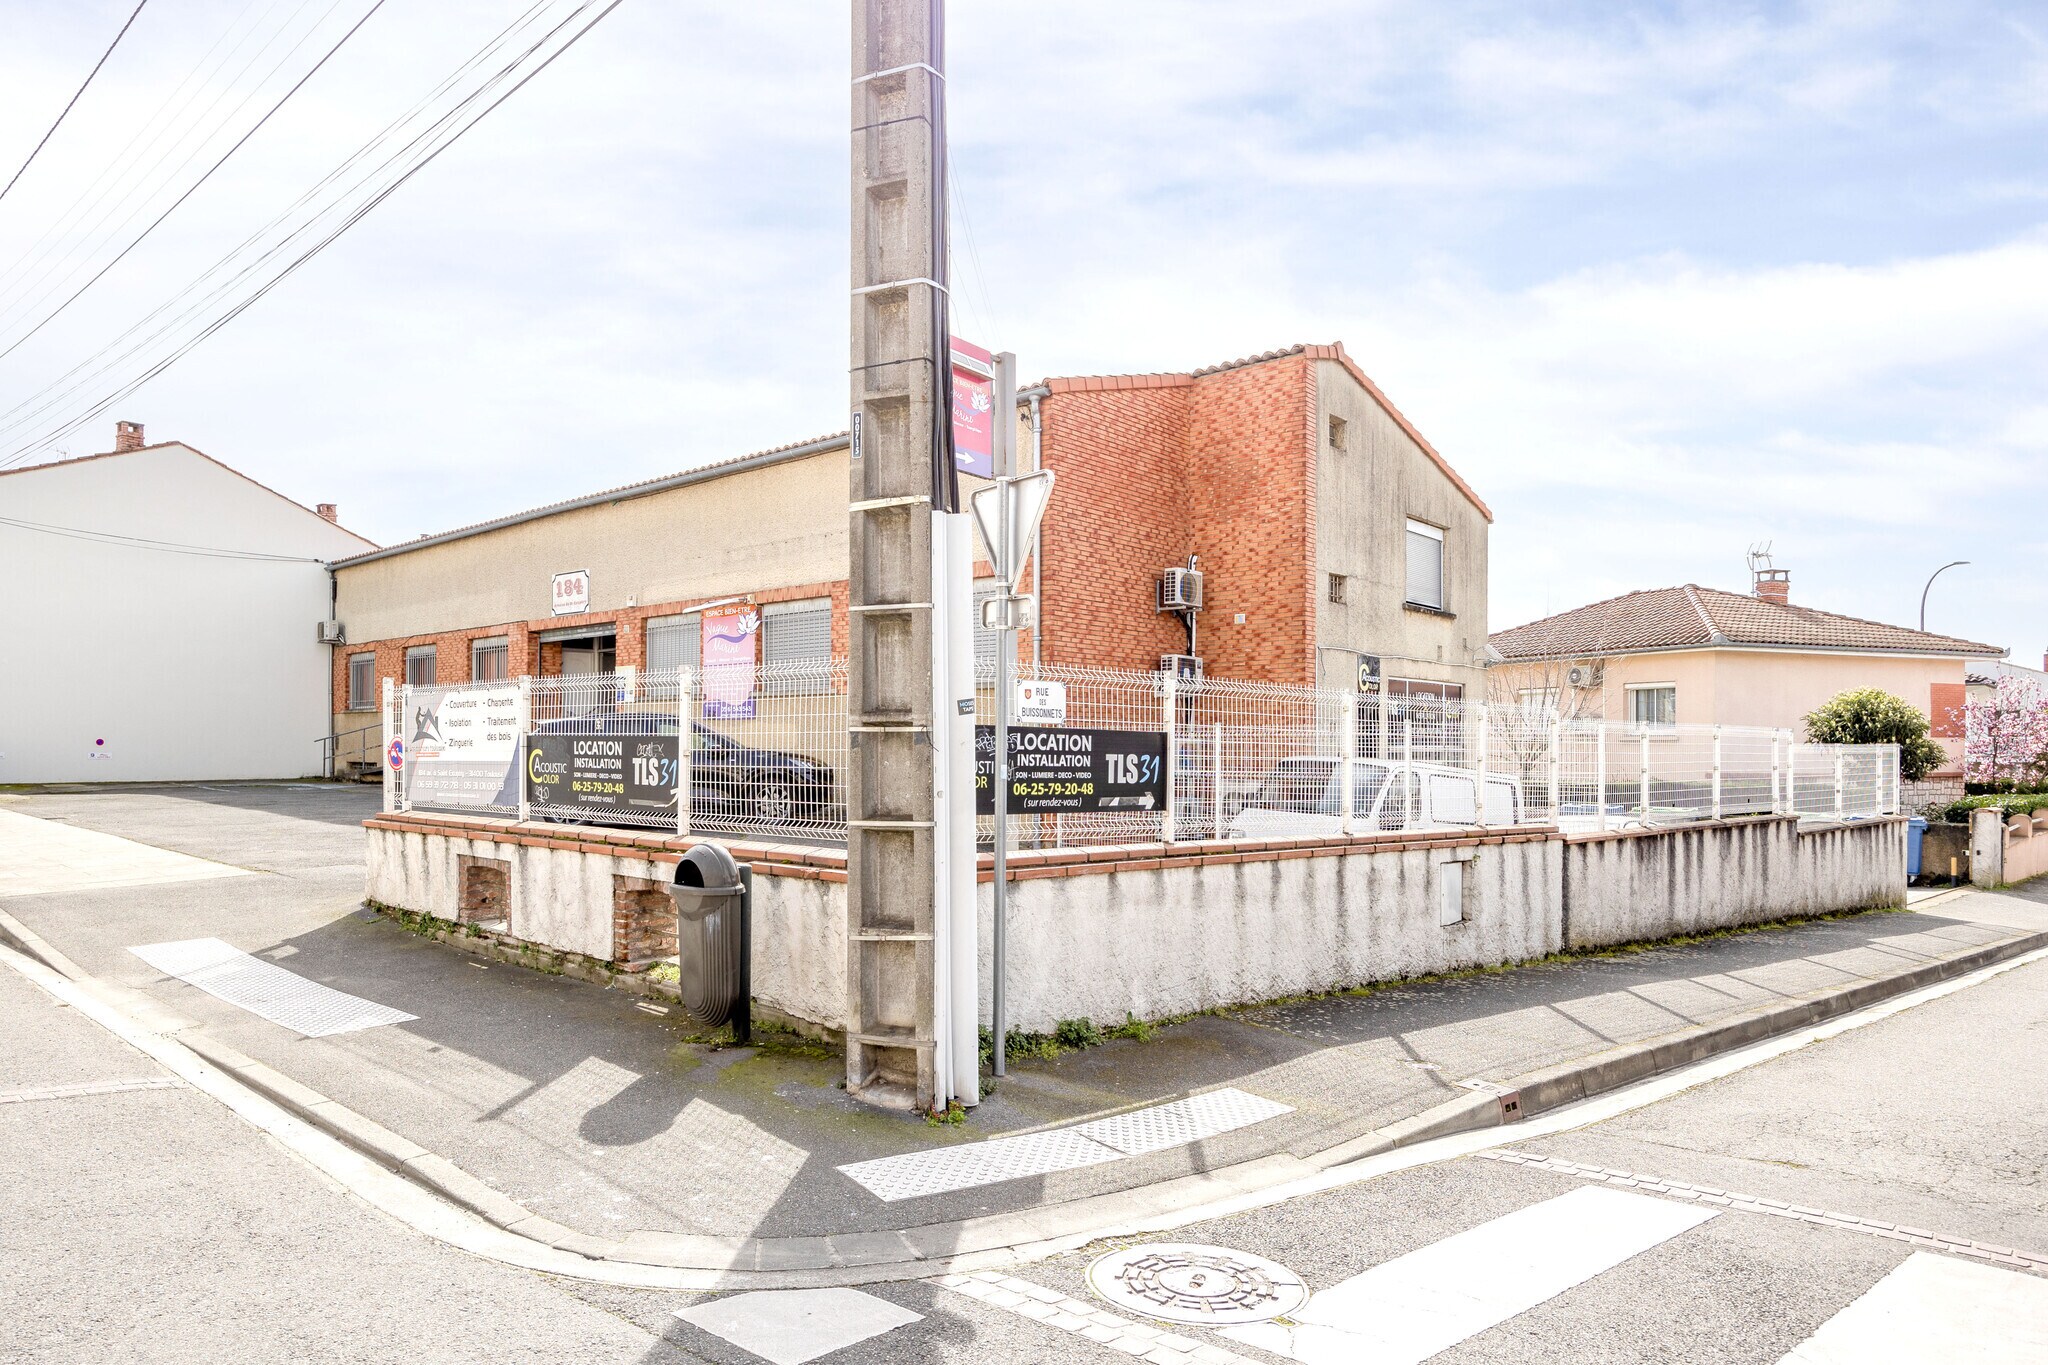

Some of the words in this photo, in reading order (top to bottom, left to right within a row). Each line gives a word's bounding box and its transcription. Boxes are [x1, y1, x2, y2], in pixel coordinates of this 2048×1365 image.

[556, 578, 583, 597] 184
[725, 606, 751, 615] BIEN-ETRE
[706, 622, 728, 635] Vague
[1036, 688, 1049, 696] RUE
[449, 700, 477, 708] Couverture
[487, 698, 514, 708] Charpente
[1022, 707, 1062, 718] BUISSONNETS
[449, 719, 472, 727] Isolation
[487, 716, 516, 726] Traitement
[498, 732, 511, 741] bois
[1017, 733, 1092, 752] LOCATION
[449, 739, 473, 748] Zinguerie
[574, 741, 622, 755] LOCATION
[574, 758, 622, 770] INSTALLATION
[1017, 754, 1090, 767] INSTALLATION
[572, 780, 624, 793] 06-25-79-20-48
[1013, 783, 1094, 795] 06-25-79-20-48
